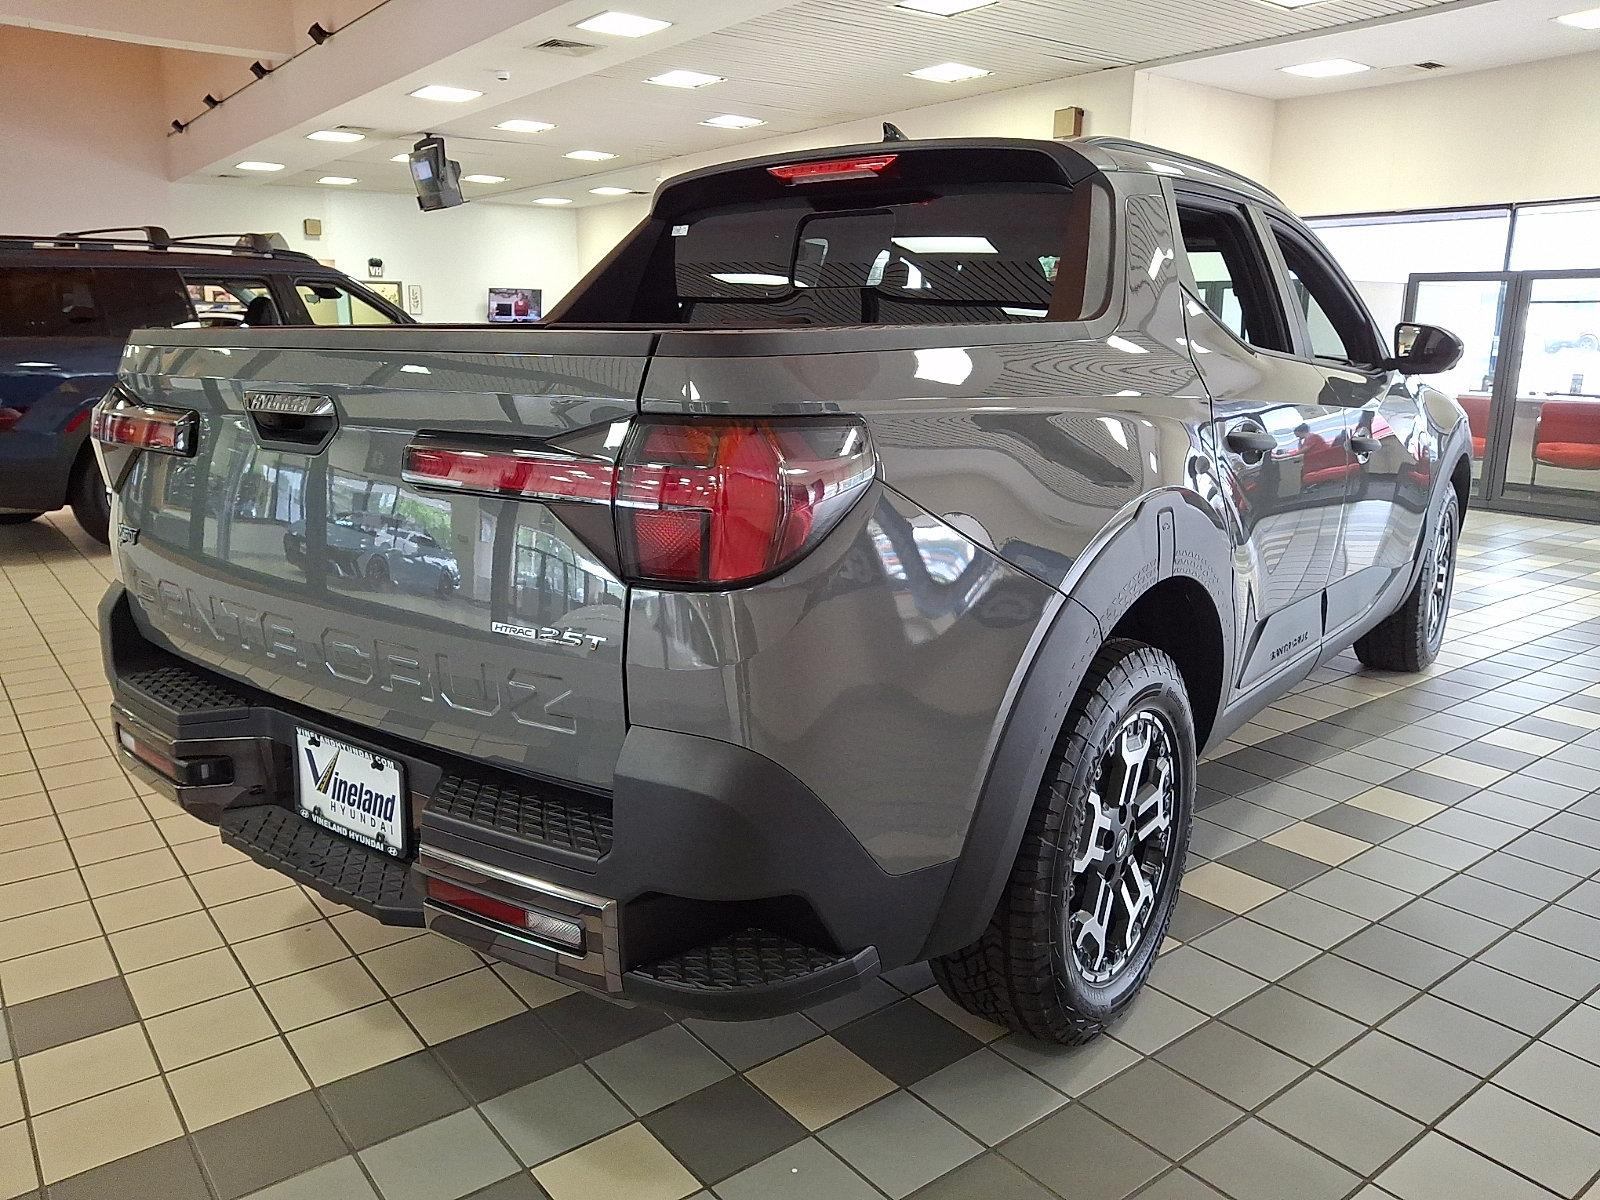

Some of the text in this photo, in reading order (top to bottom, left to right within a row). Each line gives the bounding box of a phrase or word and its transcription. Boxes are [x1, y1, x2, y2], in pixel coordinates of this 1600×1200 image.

[493, 622, 536, 638] HTRAC
[132, 569, 577, 734] SANTA CRUZ
[311, 814, 384, 852] VINELAND HYUNDAI
[330, 800, 394, 836] HYUNDAI
